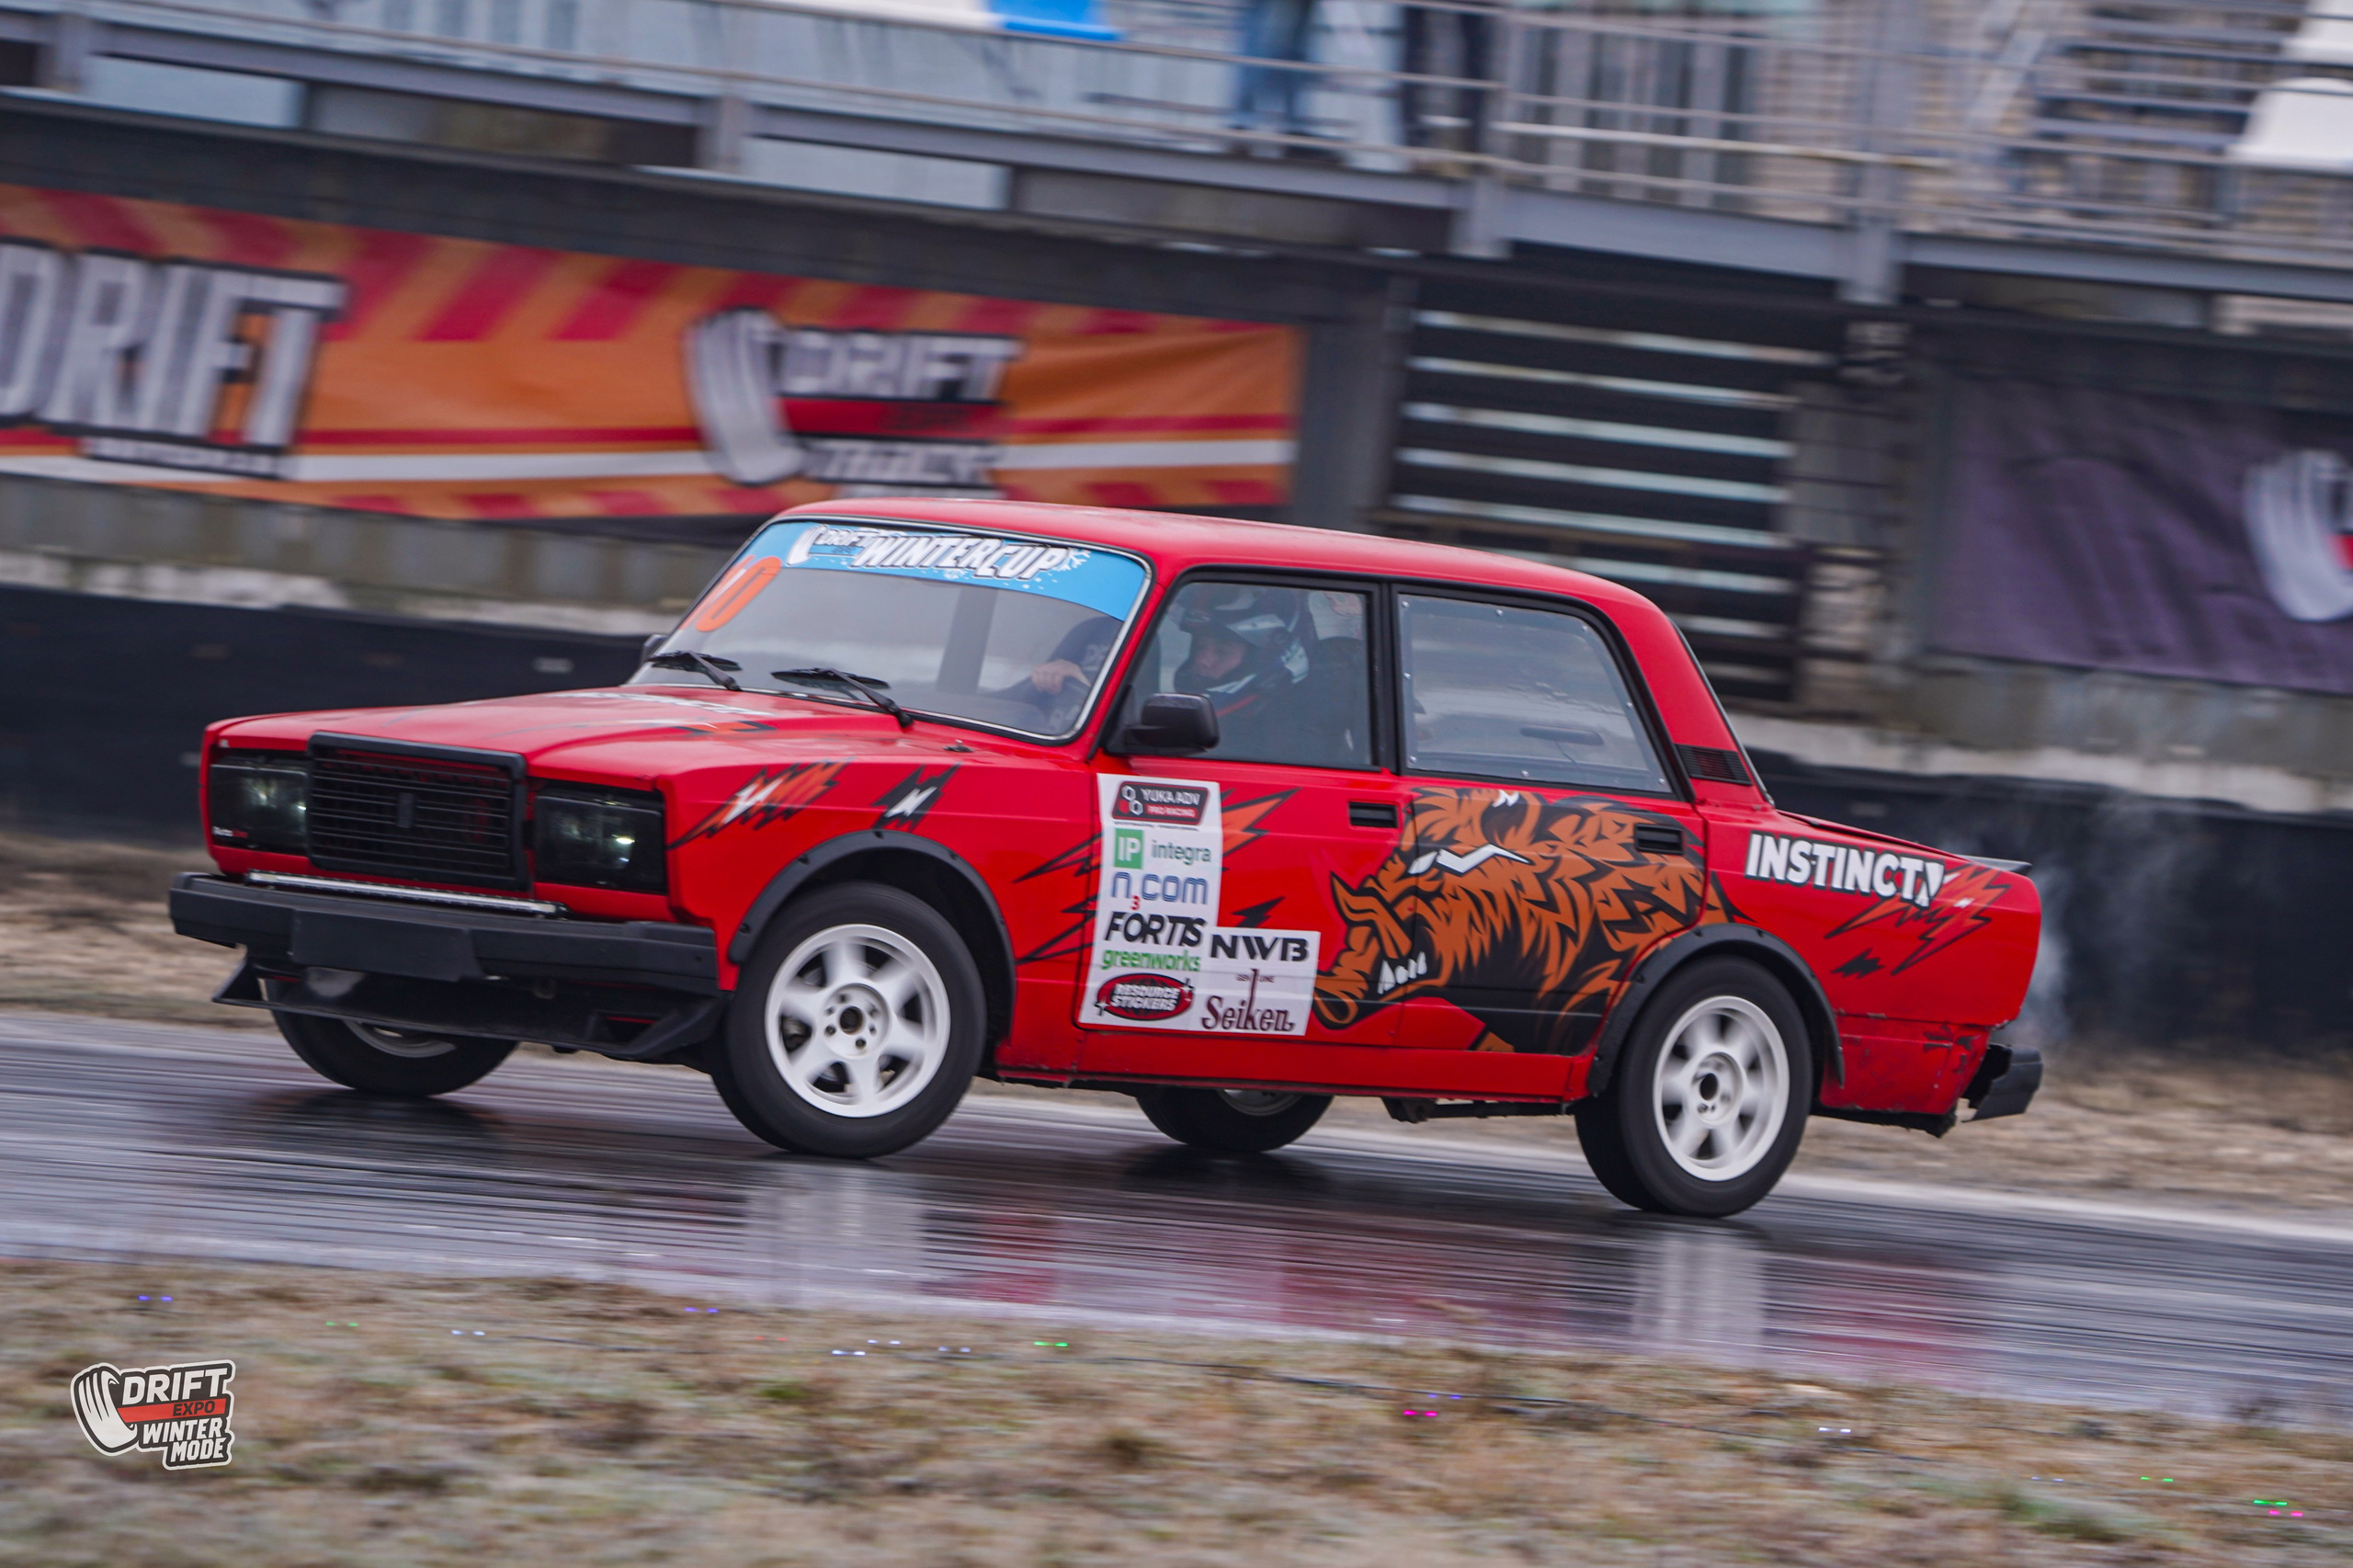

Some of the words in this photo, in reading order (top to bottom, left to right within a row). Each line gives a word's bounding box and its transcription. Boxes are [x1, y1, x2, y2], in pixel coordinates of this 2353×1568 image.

[1151, 840, 1211, 866] integra
[1104, 911, 1207, 948] FORTIS
[1100, 949, 1200, 971] greenworks
[1210, 934, 1309, 962] NWB
[1200, 968, 1296, 1031] Seiken
